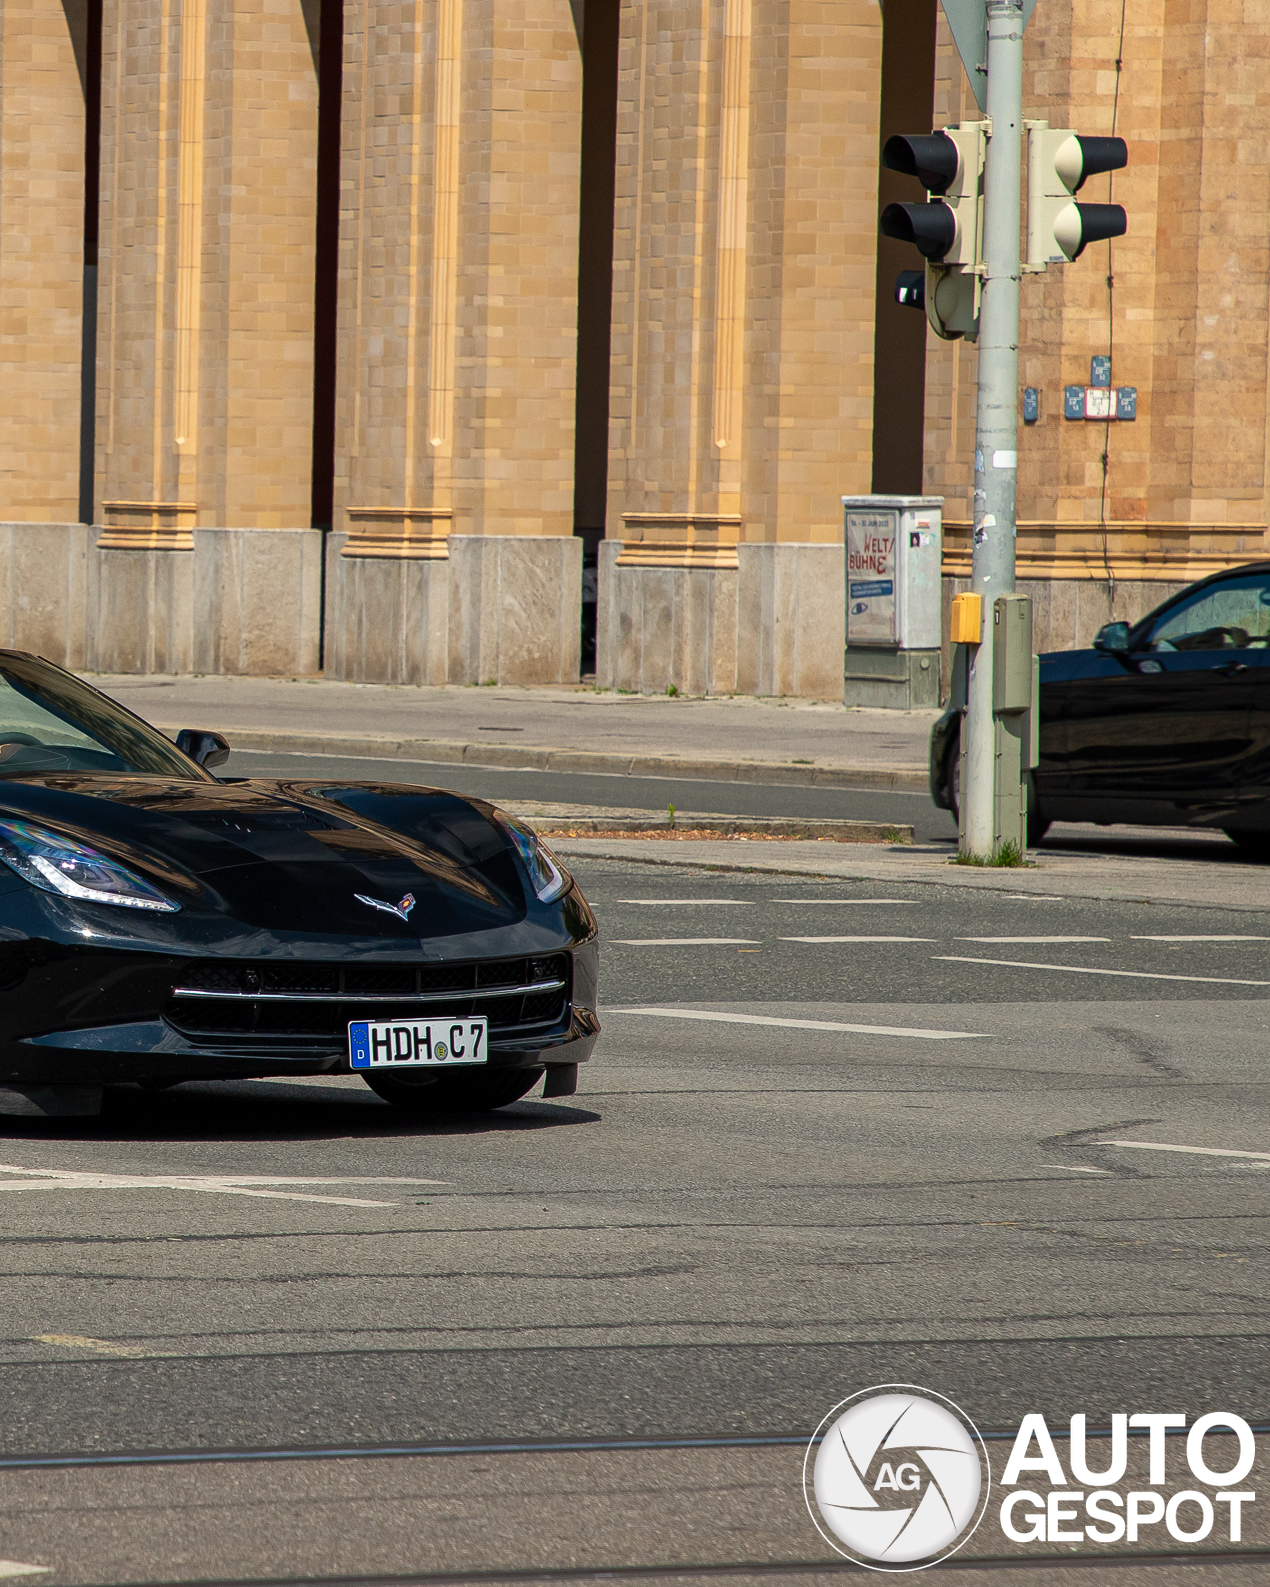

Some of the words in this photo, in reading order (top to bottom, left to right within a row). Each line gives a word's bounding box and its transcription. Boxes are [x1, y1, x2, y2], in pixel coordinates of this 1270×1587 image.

[849, 550, 887, 575] BÜHNE
[357, 1049, 365, 1060] D
[371, 1025, 433, 1062] HDH
